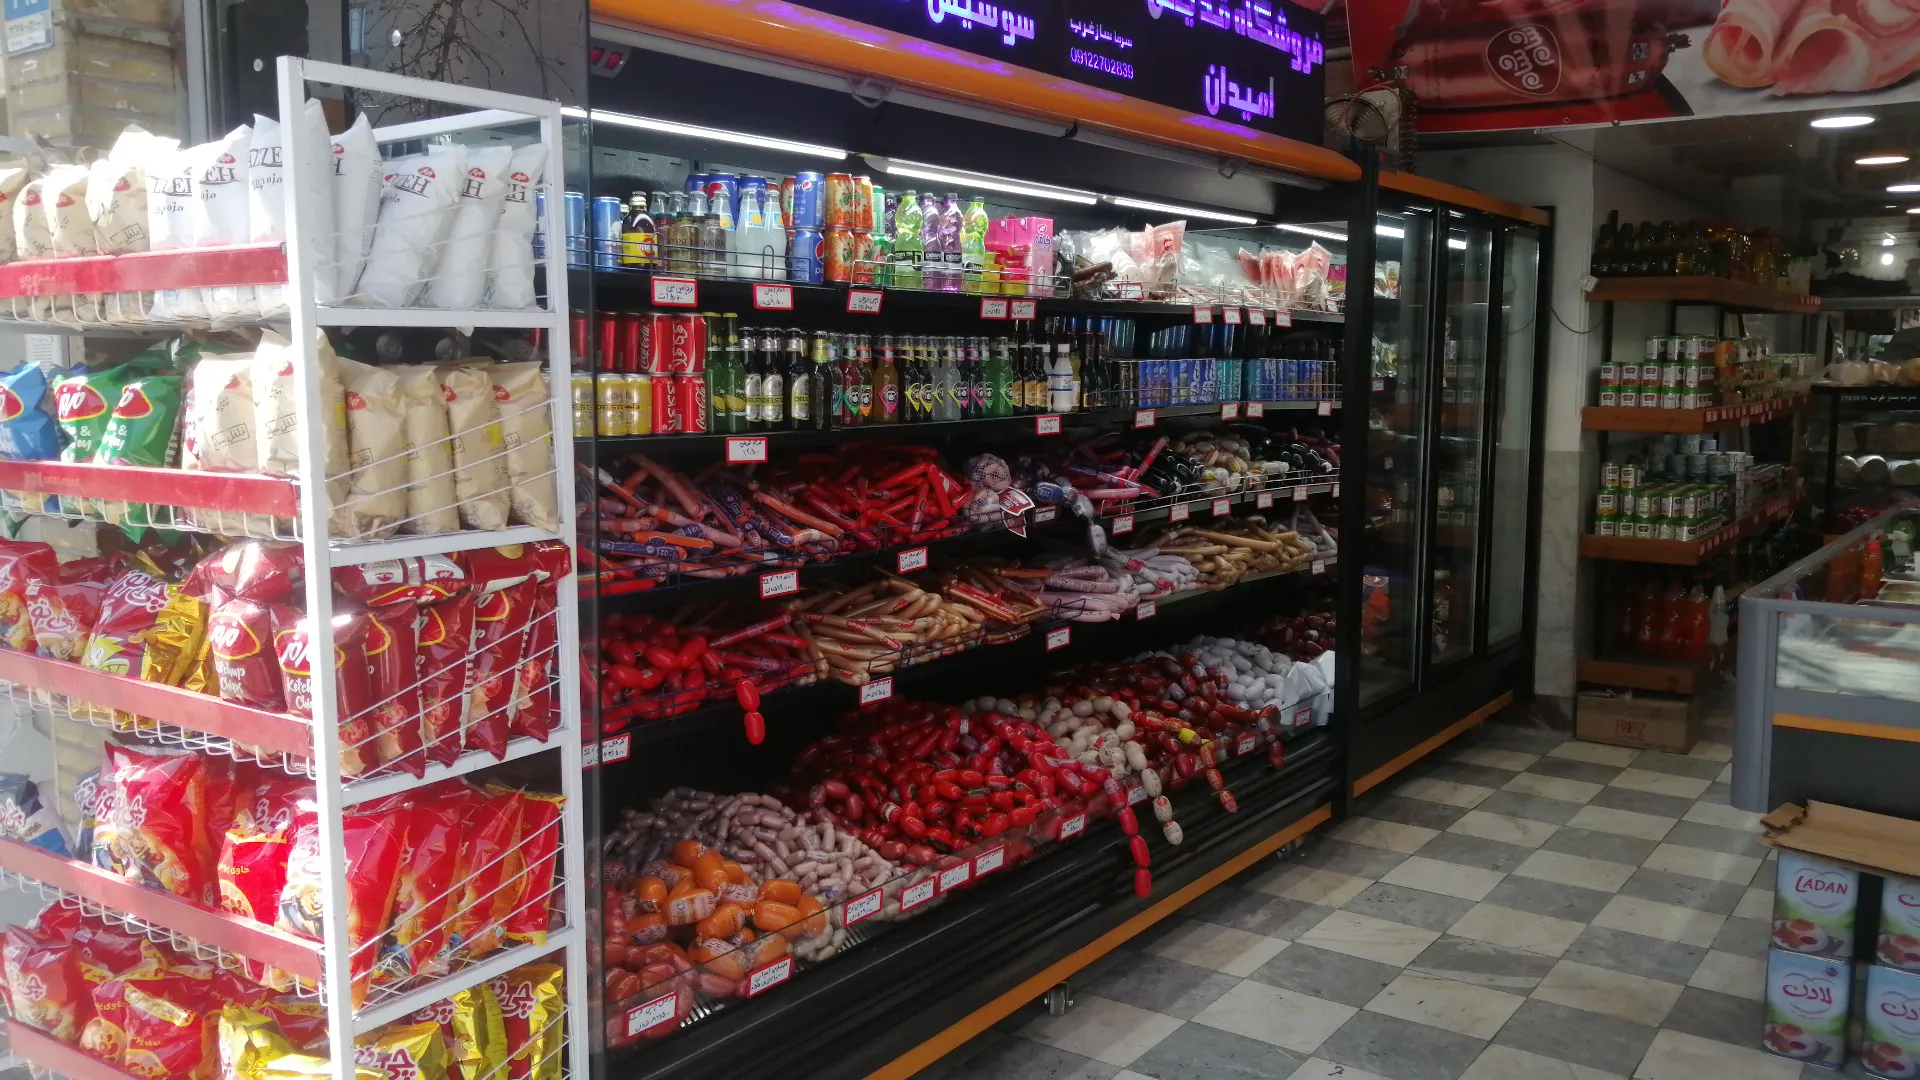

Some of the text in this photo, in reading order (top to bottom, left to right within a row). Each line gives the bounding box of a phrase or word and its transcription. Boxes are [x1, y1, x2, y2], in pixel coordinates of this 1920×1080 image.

[1069, 47, 1135, 80] 09122702839
[1795, 875, 1849, 895] LADAN
[1782, 984, 1834, 1005] لادن
